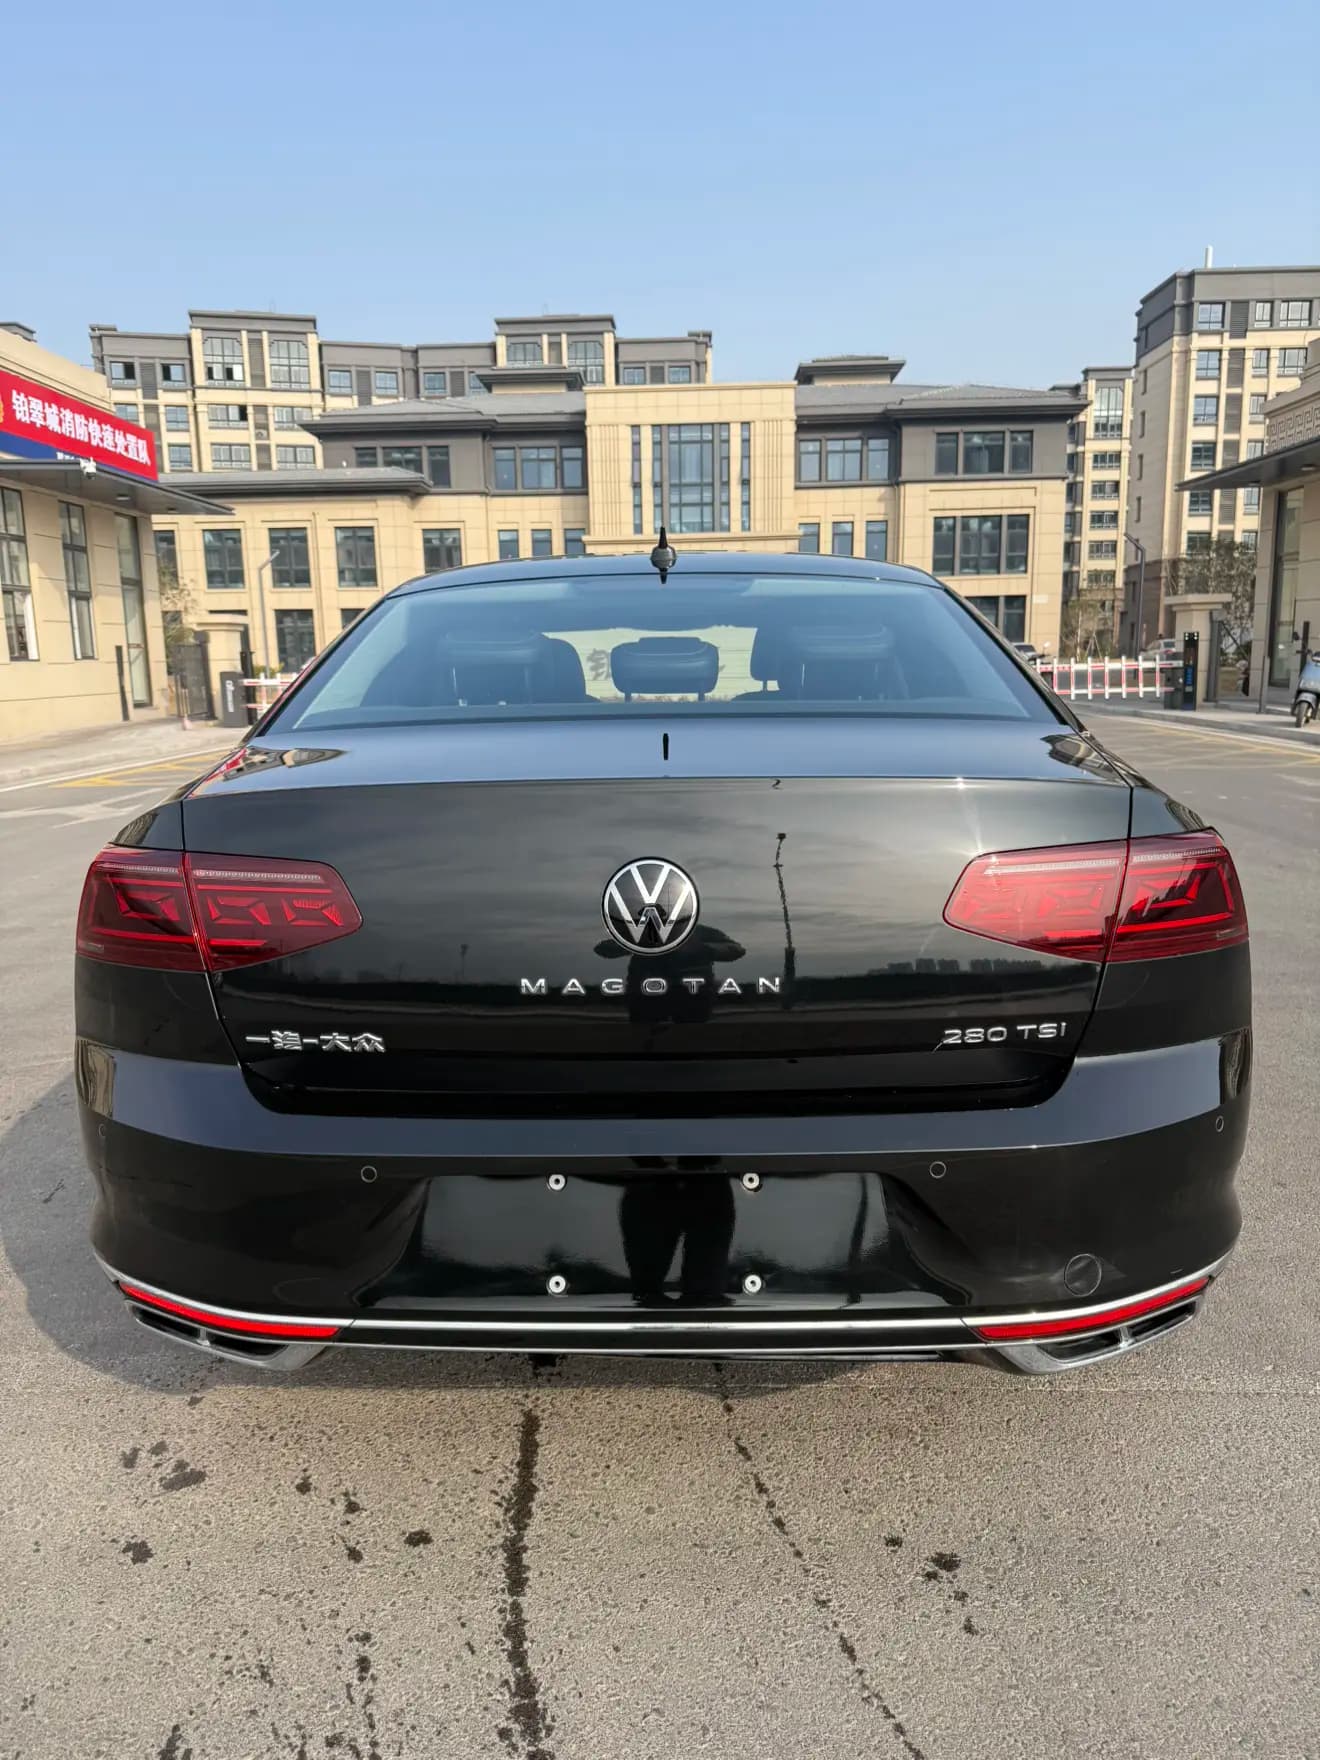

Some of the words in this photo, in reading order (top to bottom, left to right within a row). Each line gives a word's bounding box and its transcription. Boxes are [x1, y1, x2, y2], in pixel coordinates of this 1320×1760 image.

[12, 389, 151, 466] 铂翠城消防快速处置队
[520, 977, 781, 995] MAGOTAN
[942, 1026, 1007, 1044] 280
[1016, 1022, 1067, 1039] TSI
